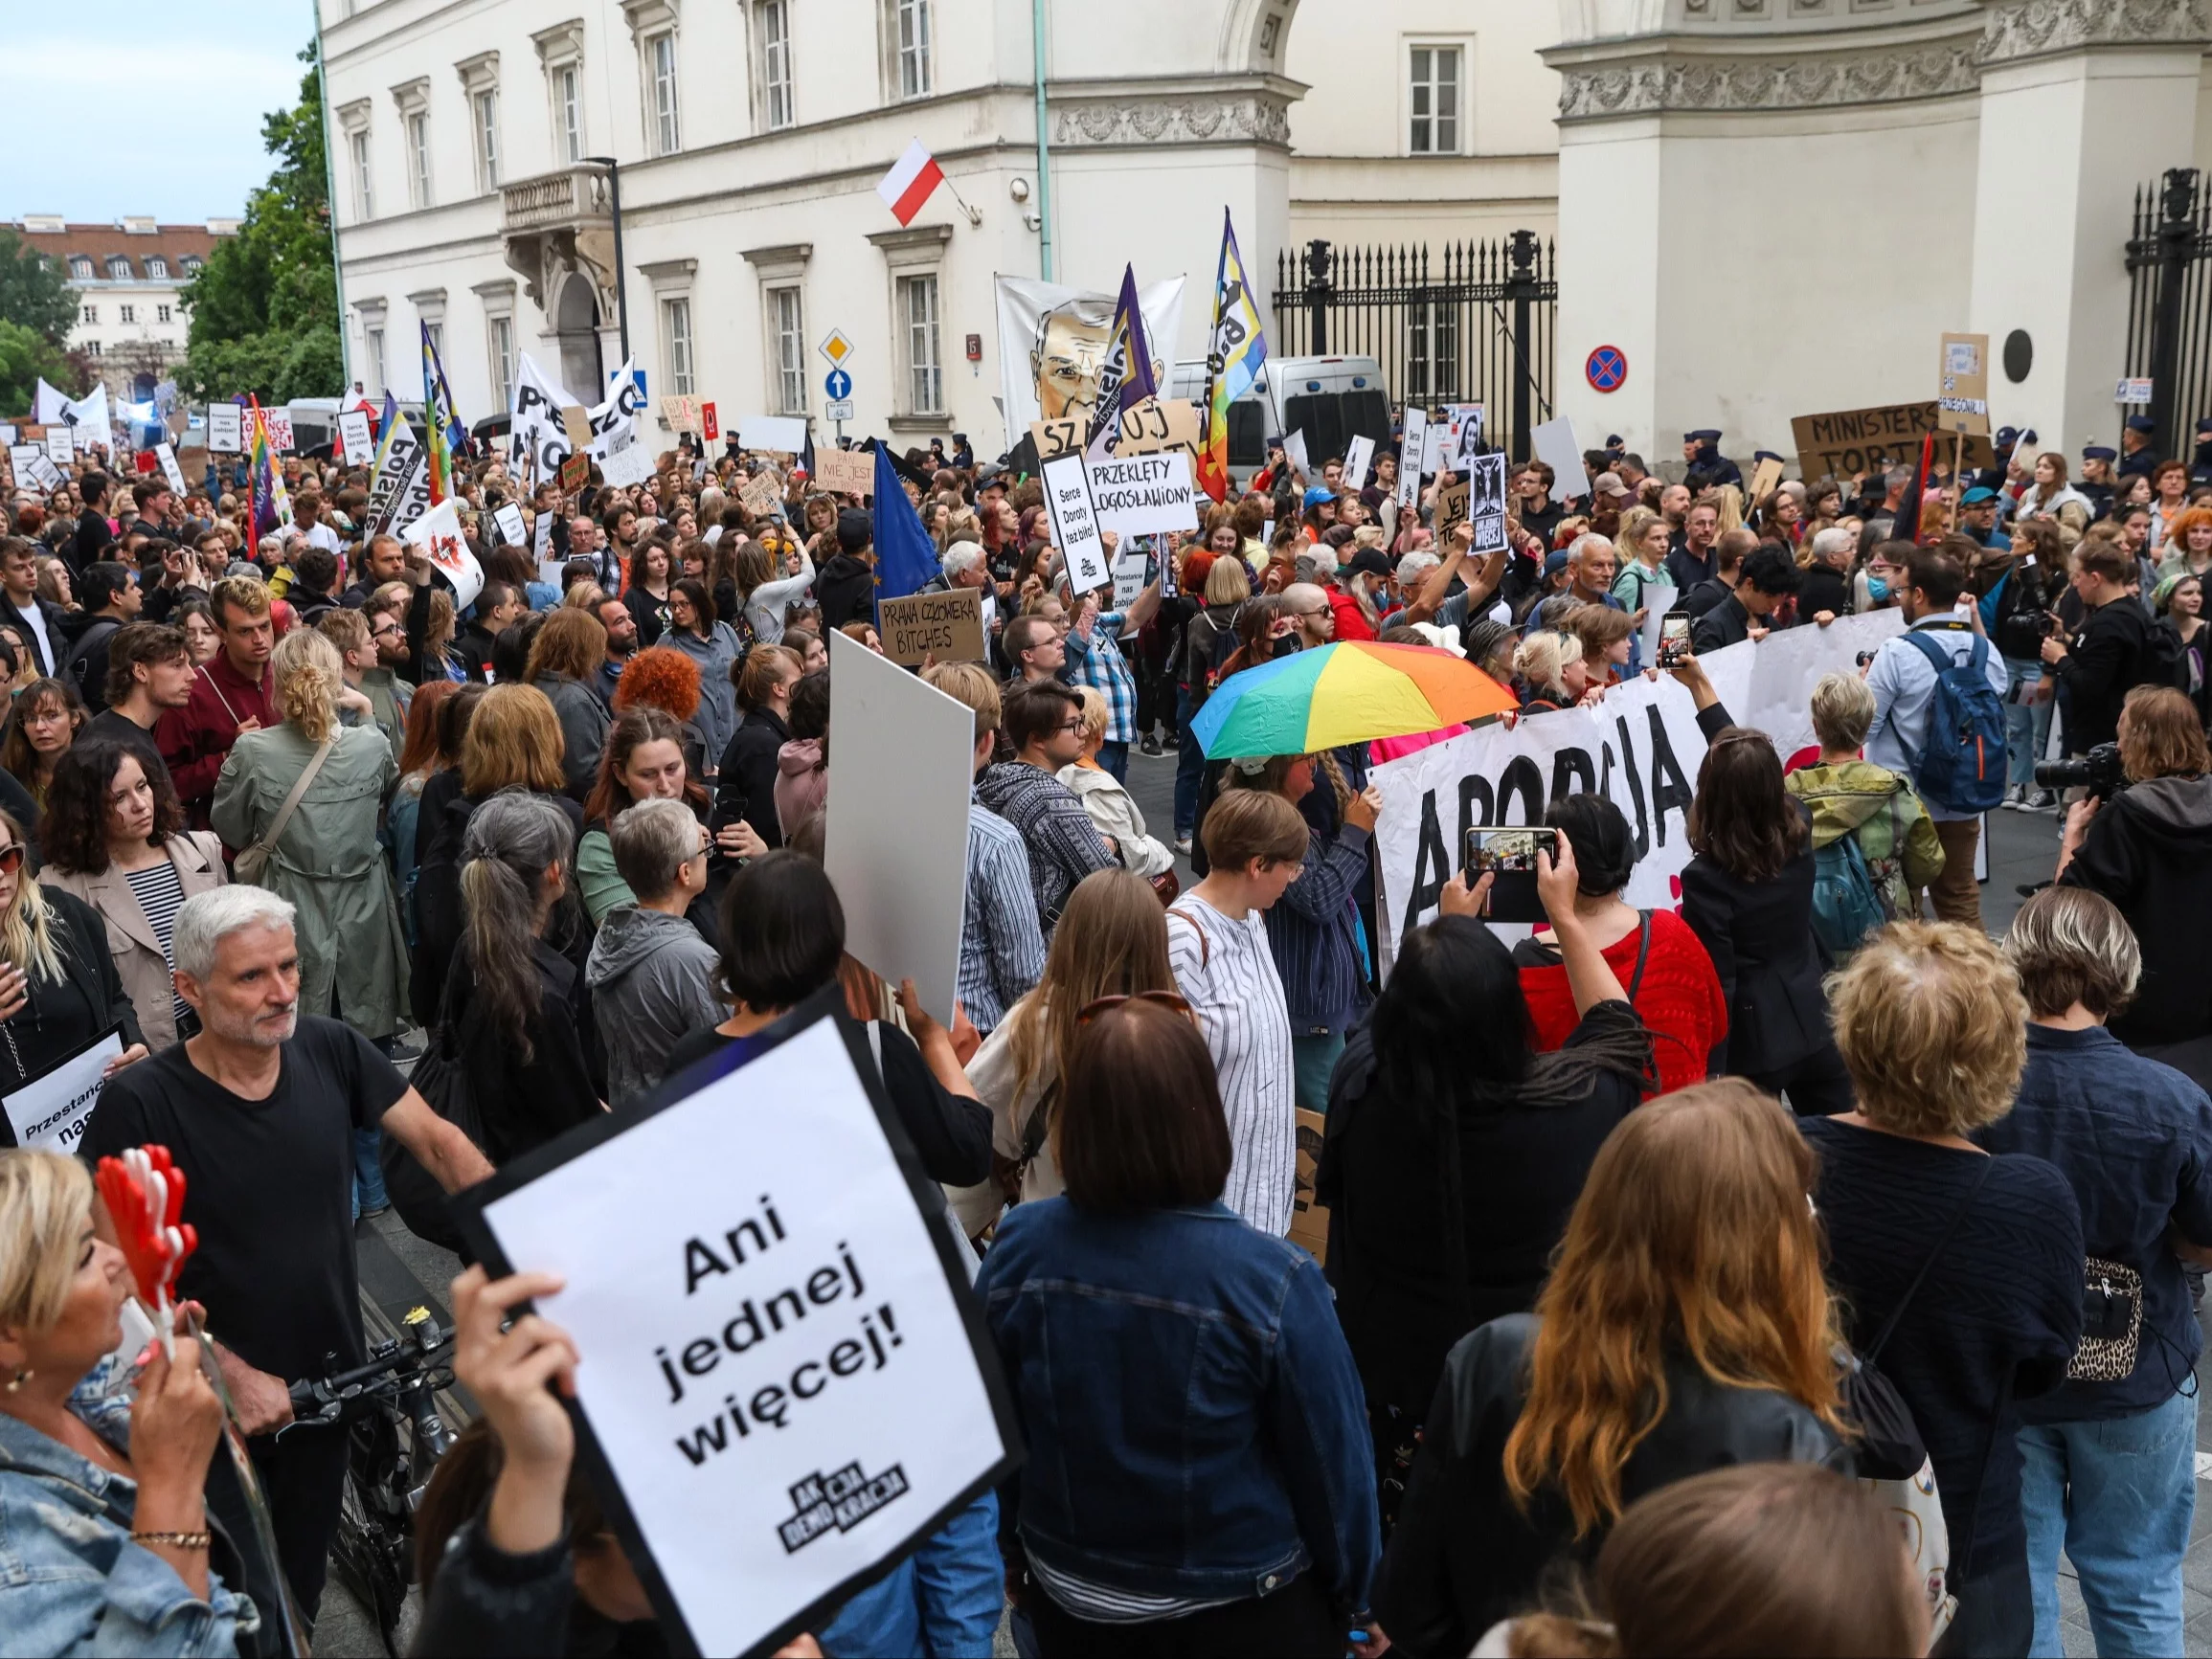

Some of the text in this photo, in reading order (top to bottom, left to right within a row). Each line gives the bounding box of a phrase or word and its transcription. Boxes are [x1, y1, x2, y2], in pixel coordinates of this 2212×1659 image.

[1944, 376, 1953, 391] PIS
[1812, 403, 1939, 443] MINISTERS
[1409, 430, 1421, 441] Serce
[836, 454, 855, 464] PAN
[1817, 437, 1975, 479] TORTUR
[824, 464, 872, 481] NIE JEST
[1093, 460, 1170, 486] PRZEKLĘTY
[1059, 487, 1081, 504] Serce
[1063, 507, 1087, 525] Doroty
[1443, 495, 1466, 523] JEJ
[1066, 524, 1095, 545] też biło!
[1476, 515, 1501, 532] ANI JEDNEJ
[1439, 526, 1456, 546] TE
[1476, 527, 1501, 549] WIĘCEJ
[883, 602, 918, 628] PRAWA
[895, 625, 952, 655] BiTCHES
[25, 1078, 106, 1141] Przestańc
[682, 1193, 787, 1296] Ani
[654, 1239, 866, 1404] jednej
[675, 1302, 905, 1468] więcej!
